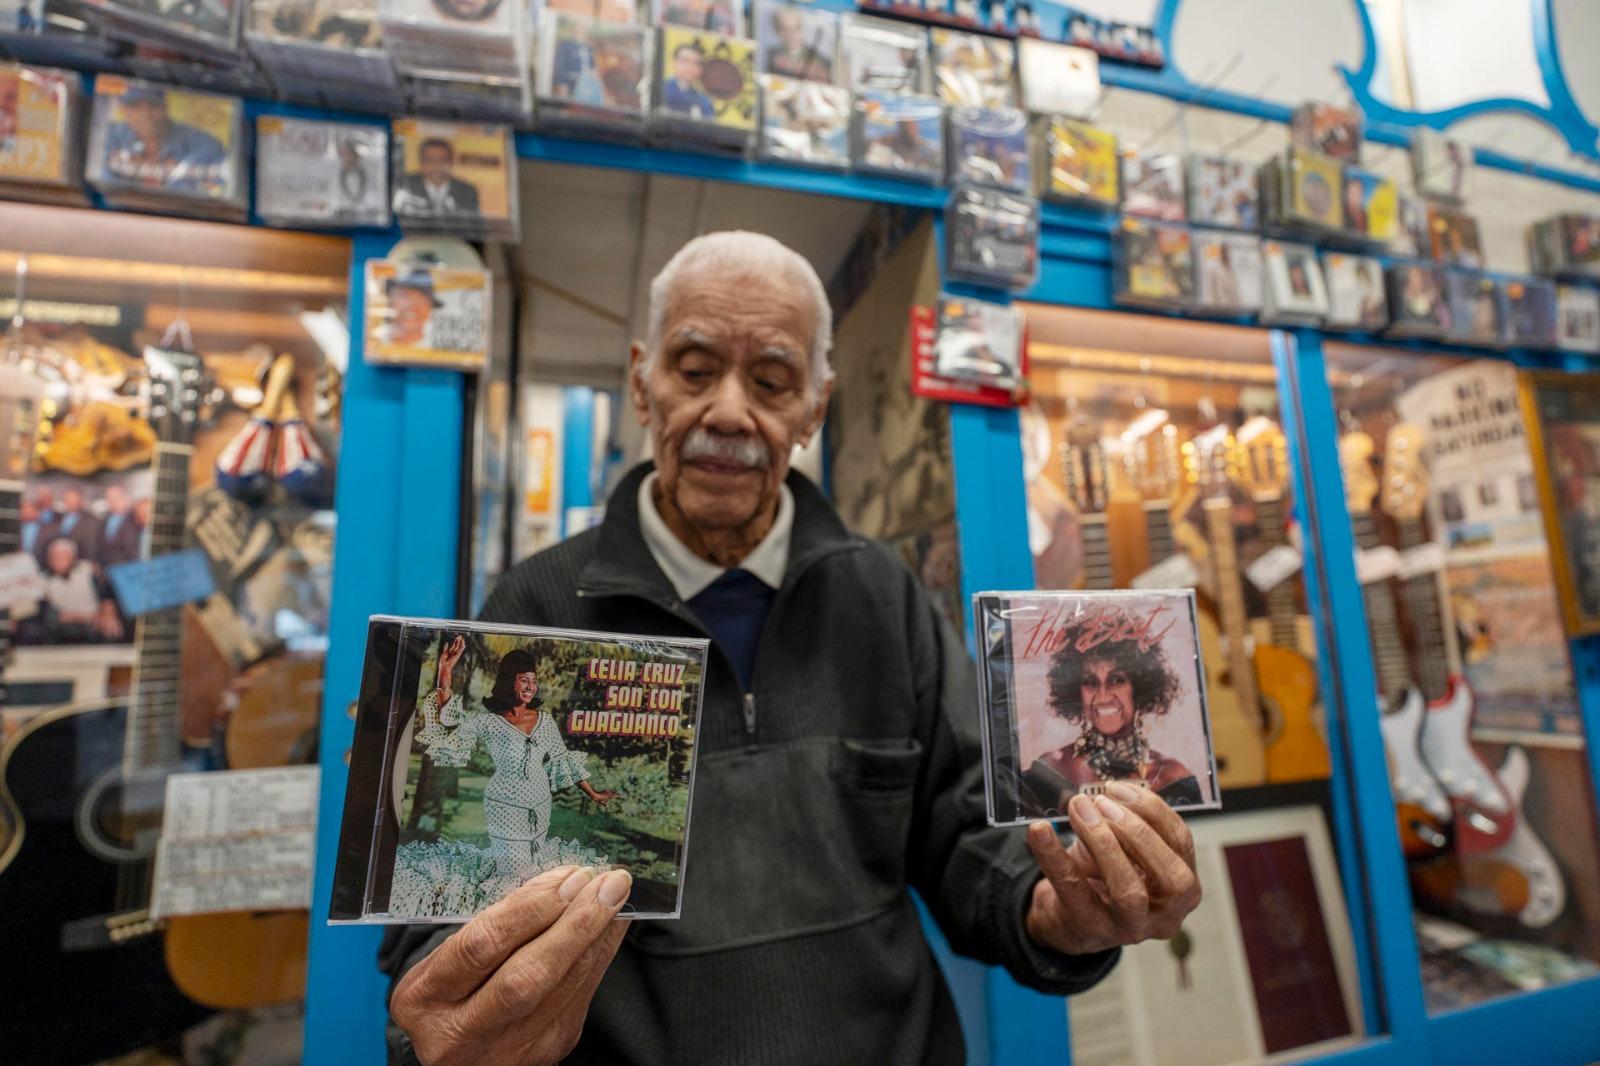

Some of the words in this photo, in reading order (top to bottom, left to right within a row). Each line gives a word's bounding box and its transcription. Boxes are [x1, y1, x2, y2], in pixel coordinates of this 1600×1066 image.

[1023, 604, 1070, 660] The
[587, 658, 637, 682] CELIA
[641, 662, 686, 686] CRUZ
[605, 685, 643, 708] SON
[648, 688, 682, 711] CON
[568, 710, 679, 737] GUAGUANCO
